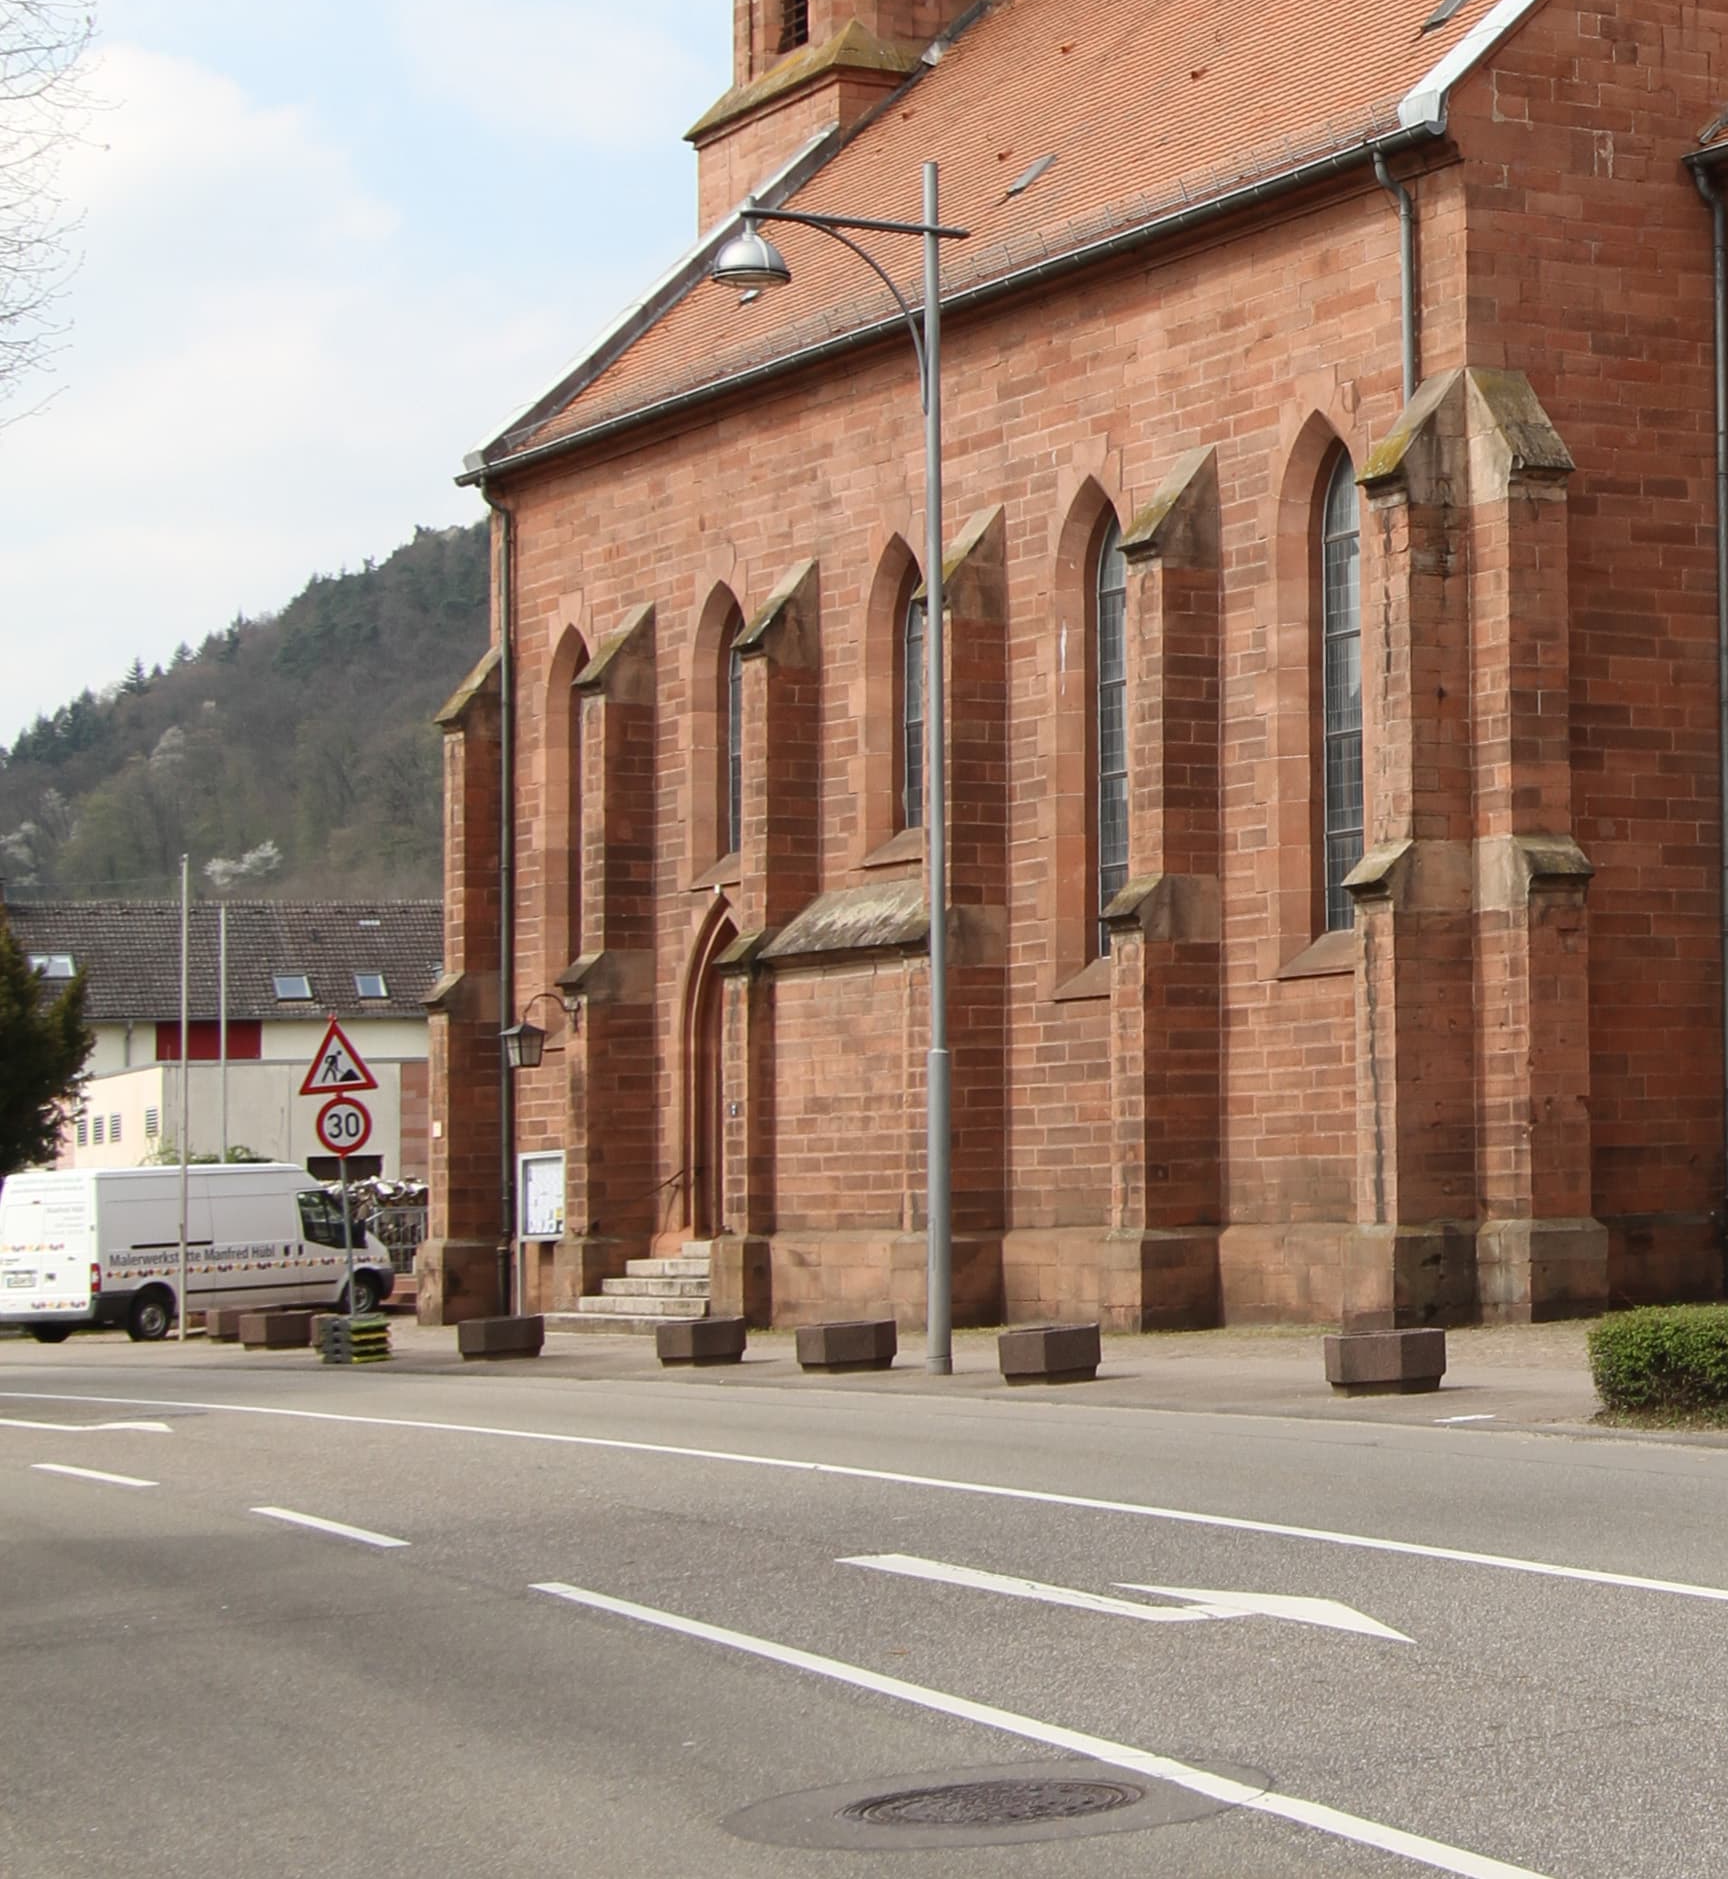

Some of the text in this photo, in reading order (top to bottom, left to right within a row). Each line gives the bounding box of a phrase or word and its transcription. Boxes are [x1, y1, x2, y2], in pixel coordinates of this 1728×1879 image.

[327, 1112, 360, 1139] 30
[109, 1244, 275, 1267] Malerwerksttte Manfred Hübl
